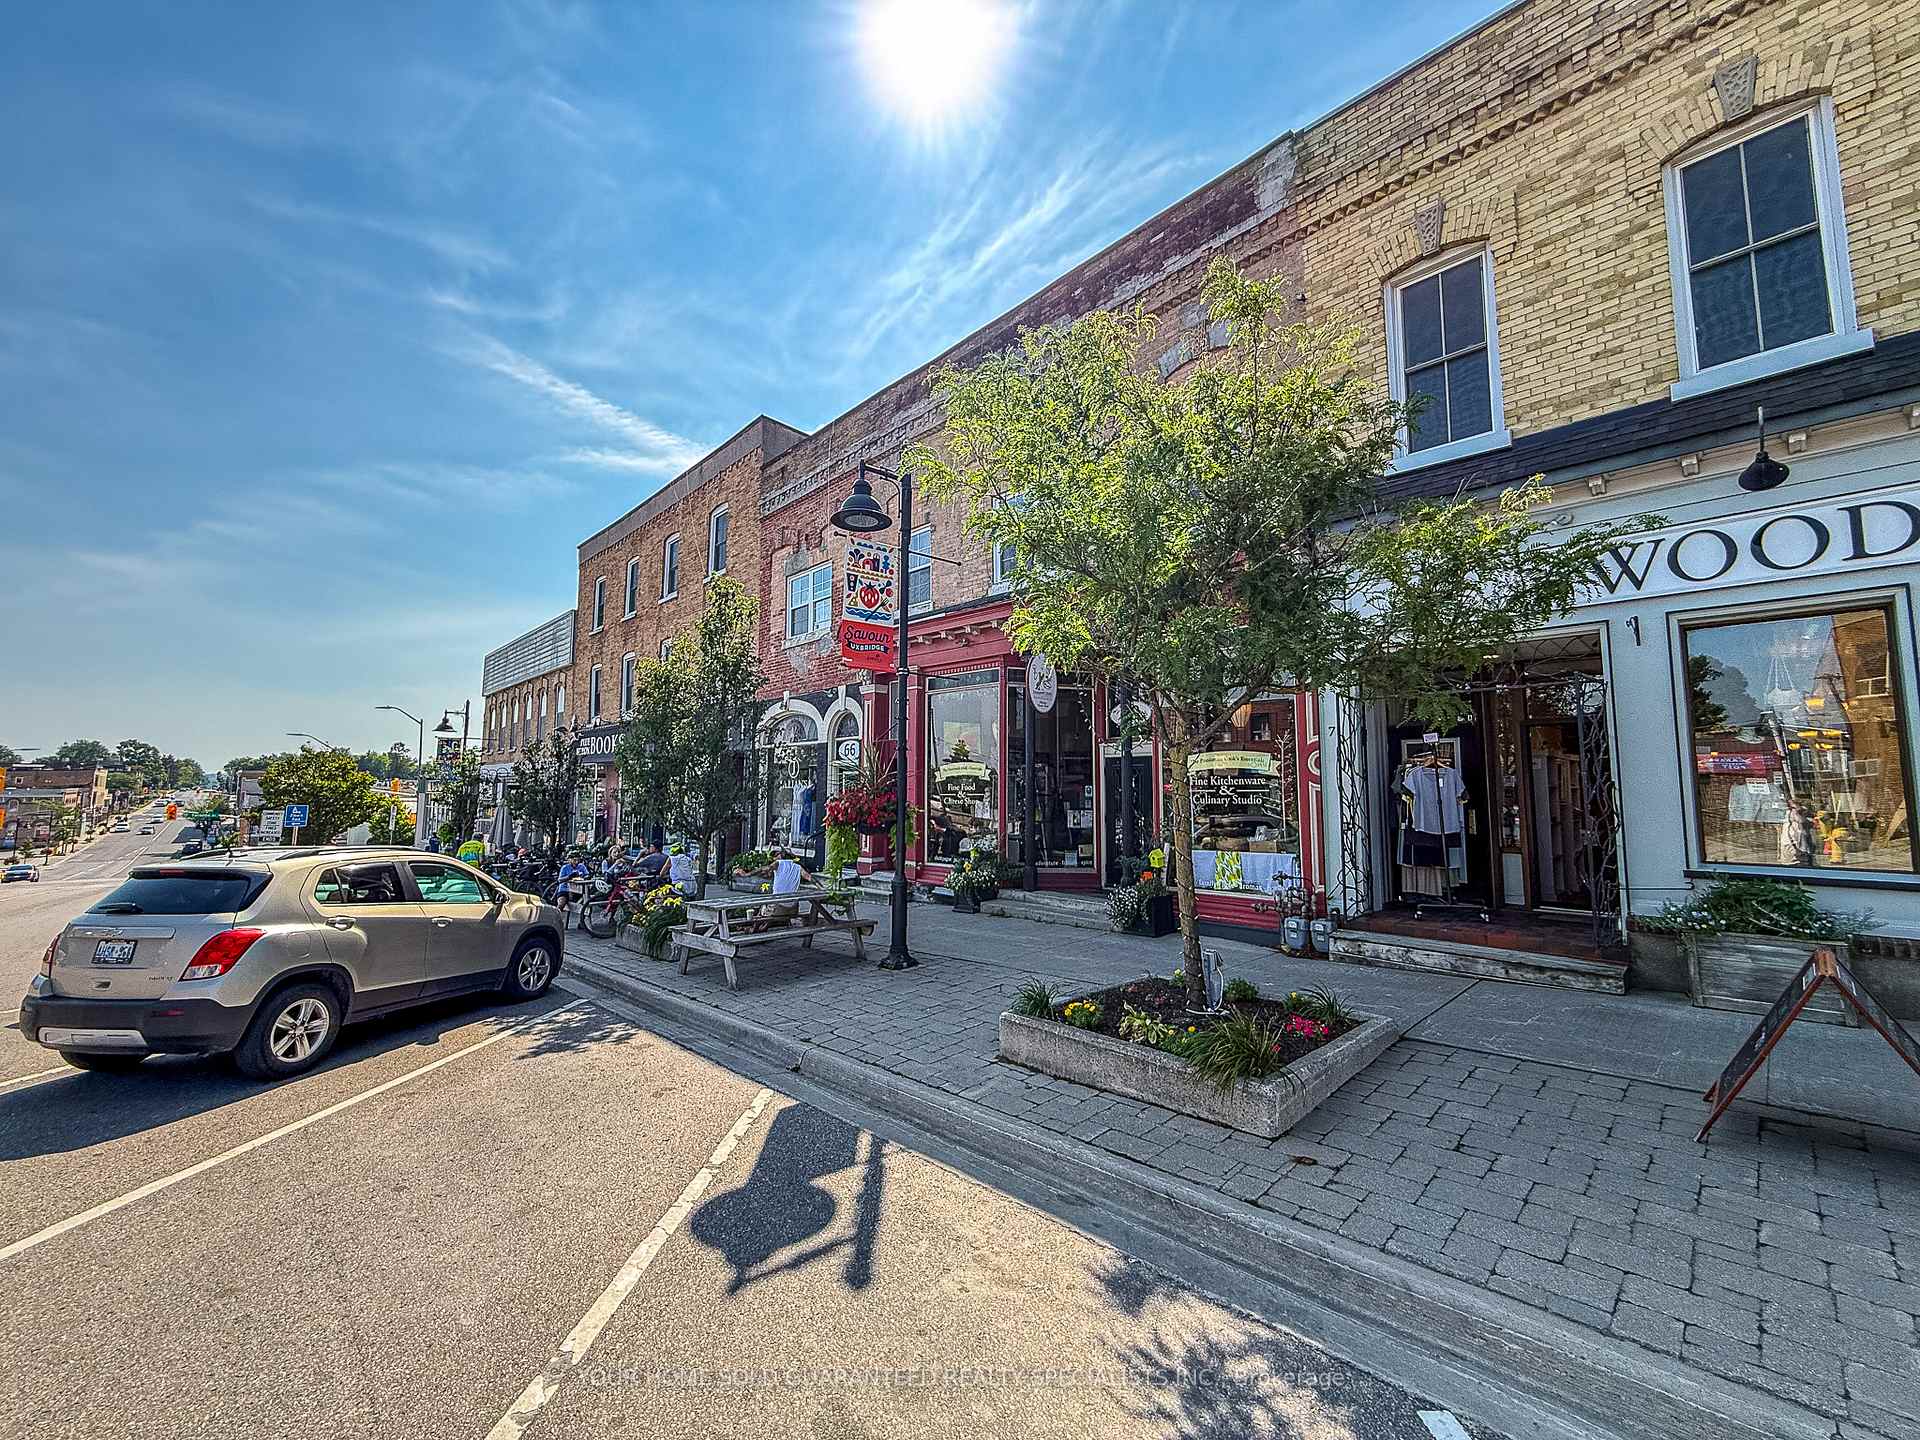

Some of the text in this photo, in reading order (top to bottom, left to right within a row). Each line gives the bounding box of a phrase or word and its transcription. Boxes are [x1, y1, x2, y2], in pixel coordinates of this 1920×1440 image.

[844, 625, 891, 643] Savour
[850, 642, 885, 652] UXBRIDGE
[1328, 726, 1336, 737] 7
[844, 743, 856, 757] 66
[1189, 775, 1266, 786] Fine Kitchenware
[947, 782, 976, 791] Fine Food
[1219, 785, 1235, 796] &
[1192, 793, 1262, 807] Culinary Studio
